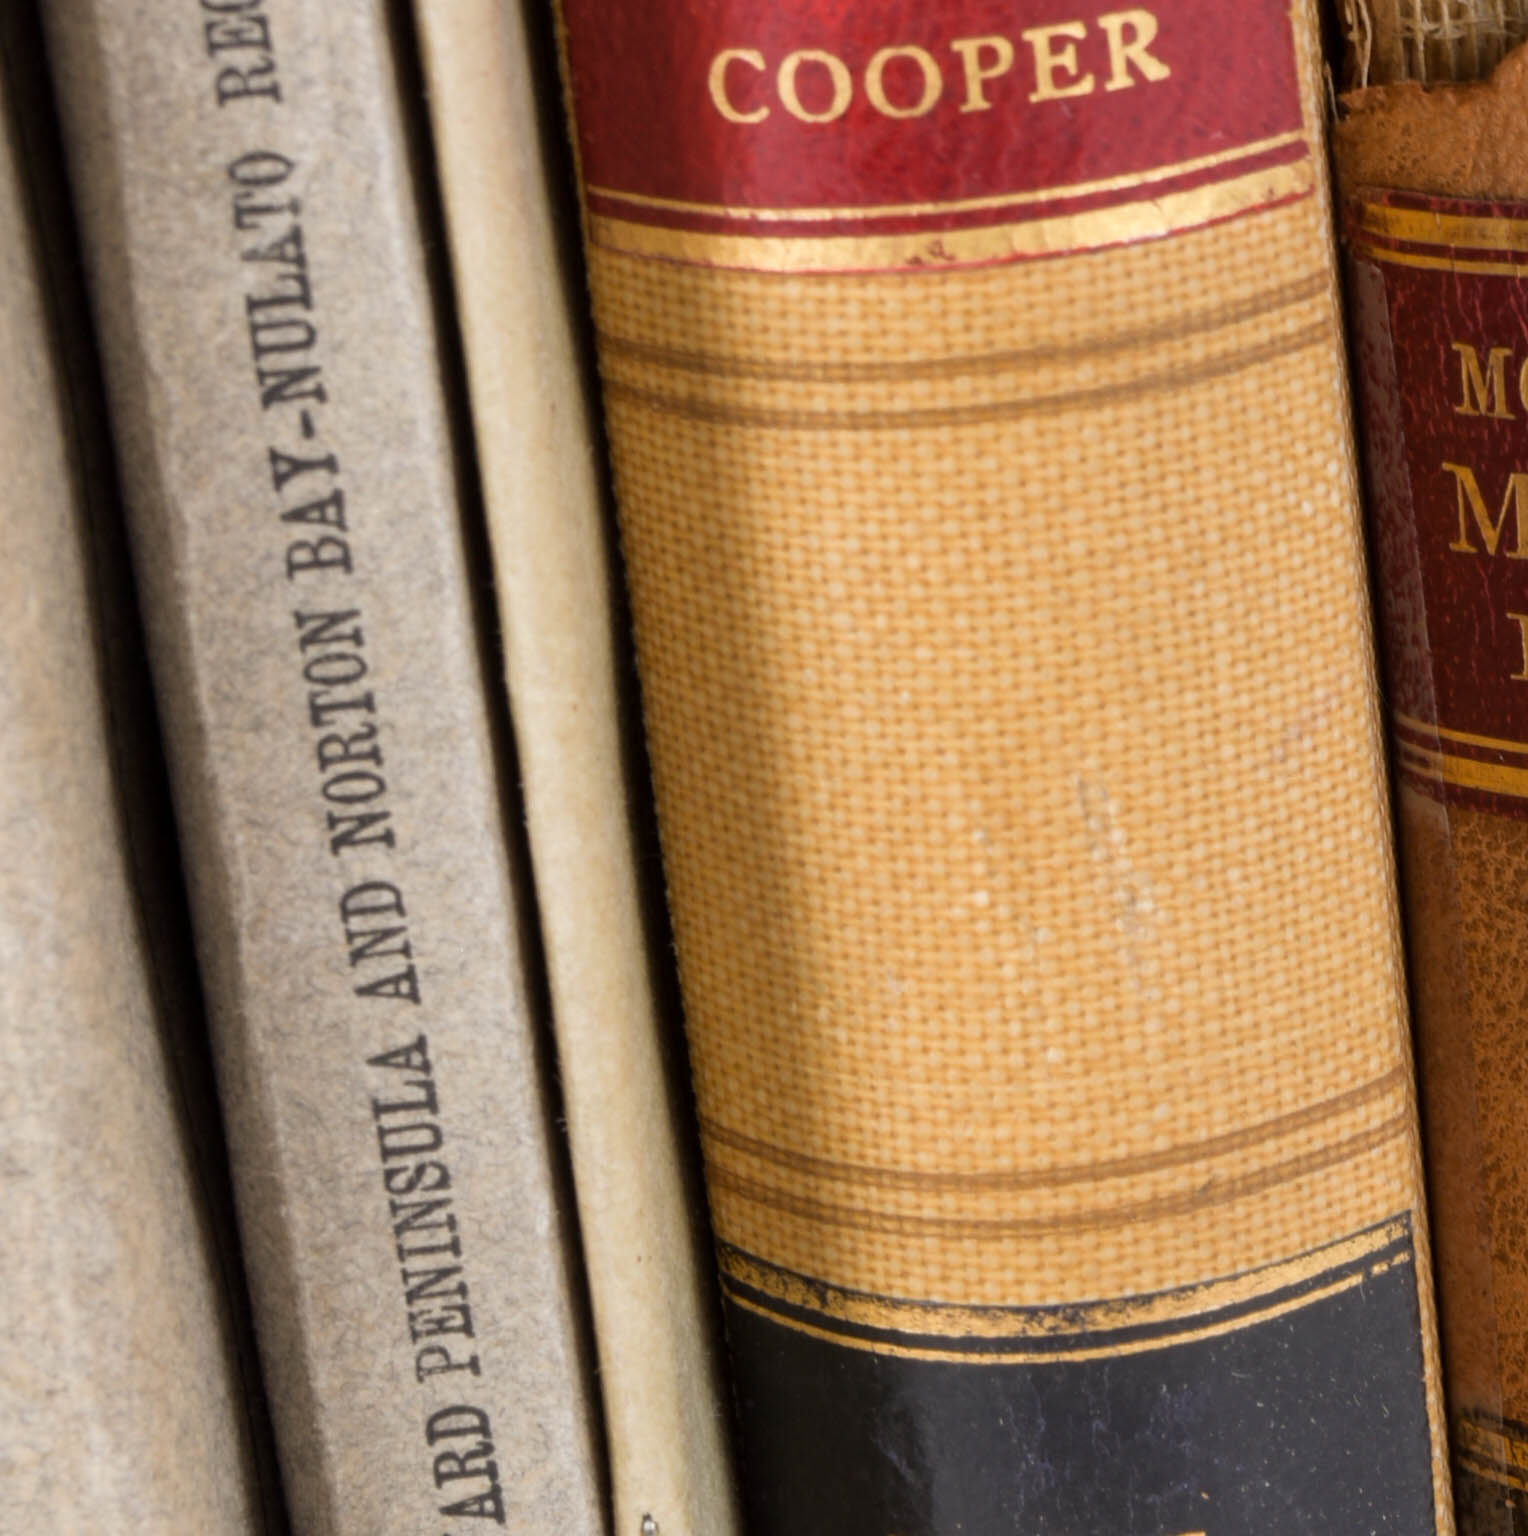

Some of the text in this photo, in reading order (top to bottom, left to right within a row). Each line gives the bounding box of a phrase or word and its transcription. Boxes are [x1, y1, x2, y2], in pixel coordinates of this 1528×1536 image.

[707, 8, 1172, 124] COOPER
[228, 150, 353, 581] BAY-NULATO
[295, 608, 396, 852] NORTON
[340, 879, 421, 1005] AND
[366, 1034, 480, 1383] PENINSULA
